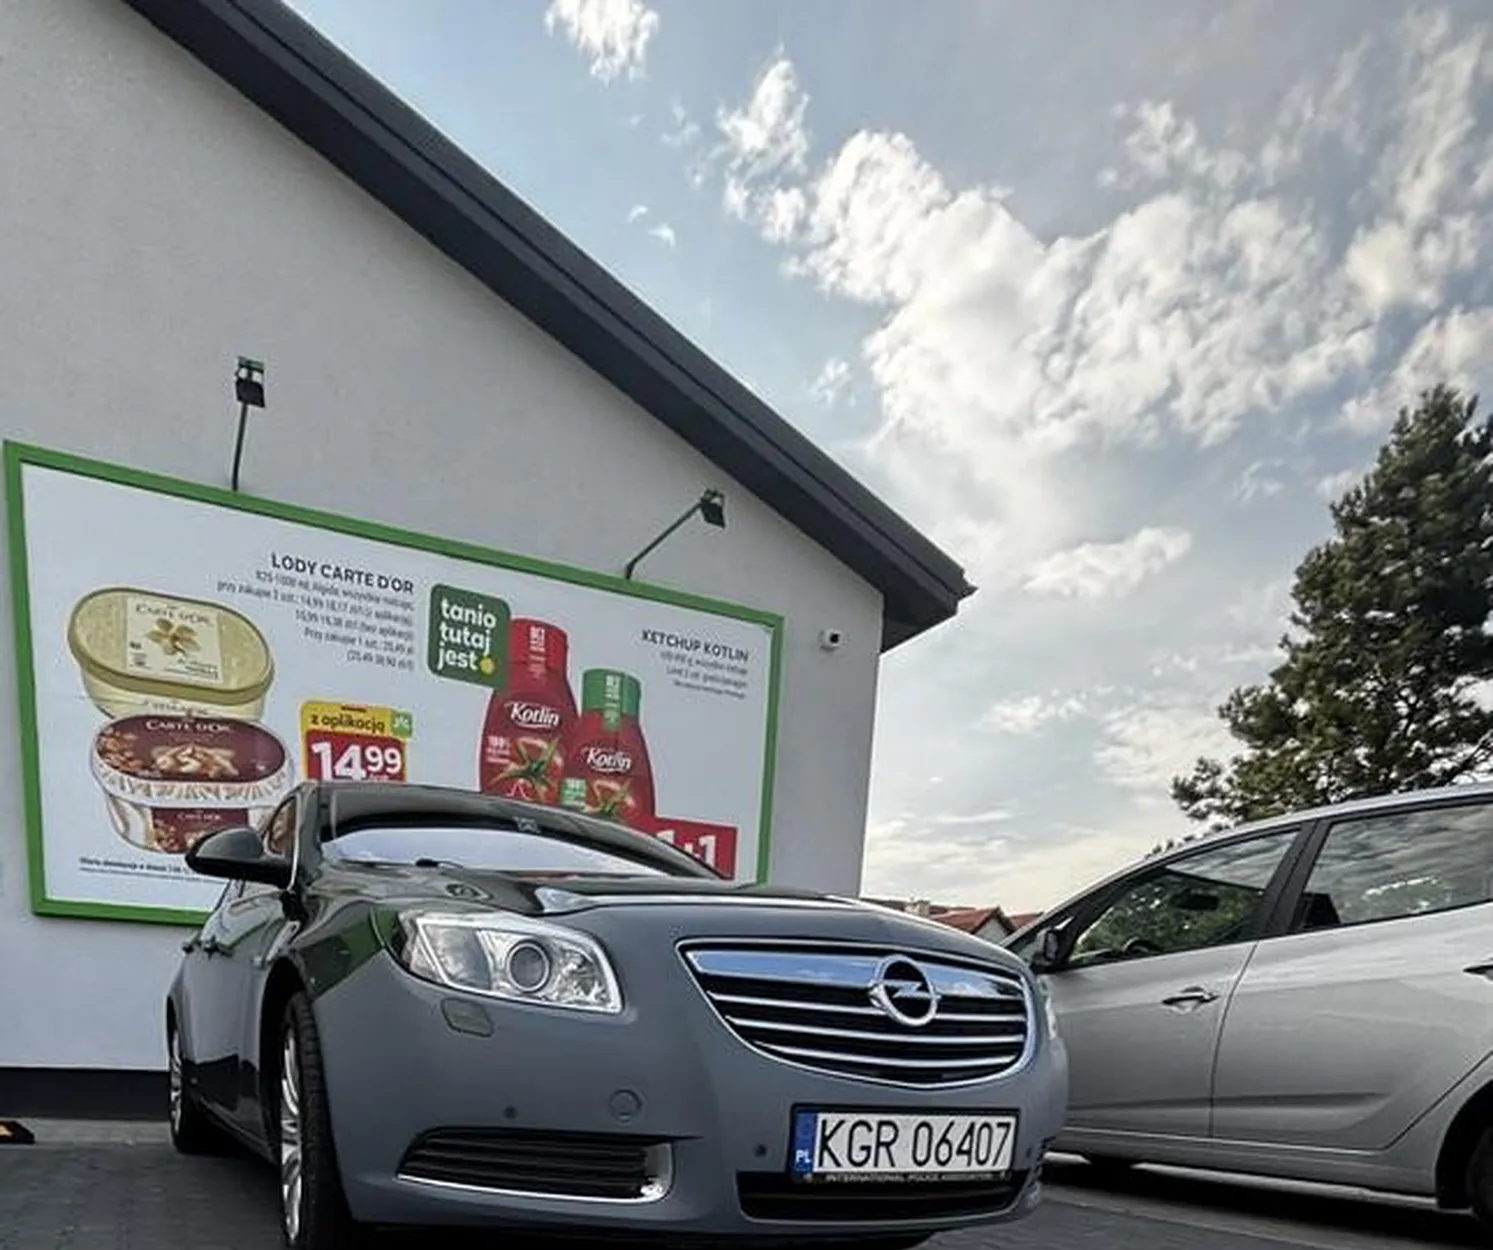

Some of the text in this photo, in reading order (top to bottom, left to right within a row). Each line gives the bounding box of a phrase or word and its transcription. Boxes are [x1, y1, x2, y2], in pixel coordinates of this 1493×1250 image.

[271, 552, 318, 575] LODY
[320, 563, 374, 587] CARTE
[377, 575, 414, 594] D'OR
[441, 597, 497, 629] tanio
[439, 621, 491, 657] tutaj
[642, 628, 701, 652] KETCHUP
[703, 642, 748, 663] KOTLIN
[510, 702, 560, 727] Kotlin
[586, 746, 632, 771] Kotlin
[795, 1149, 811, 1164] PL
[818, 1119, 1012, 1168] KGR 06407
